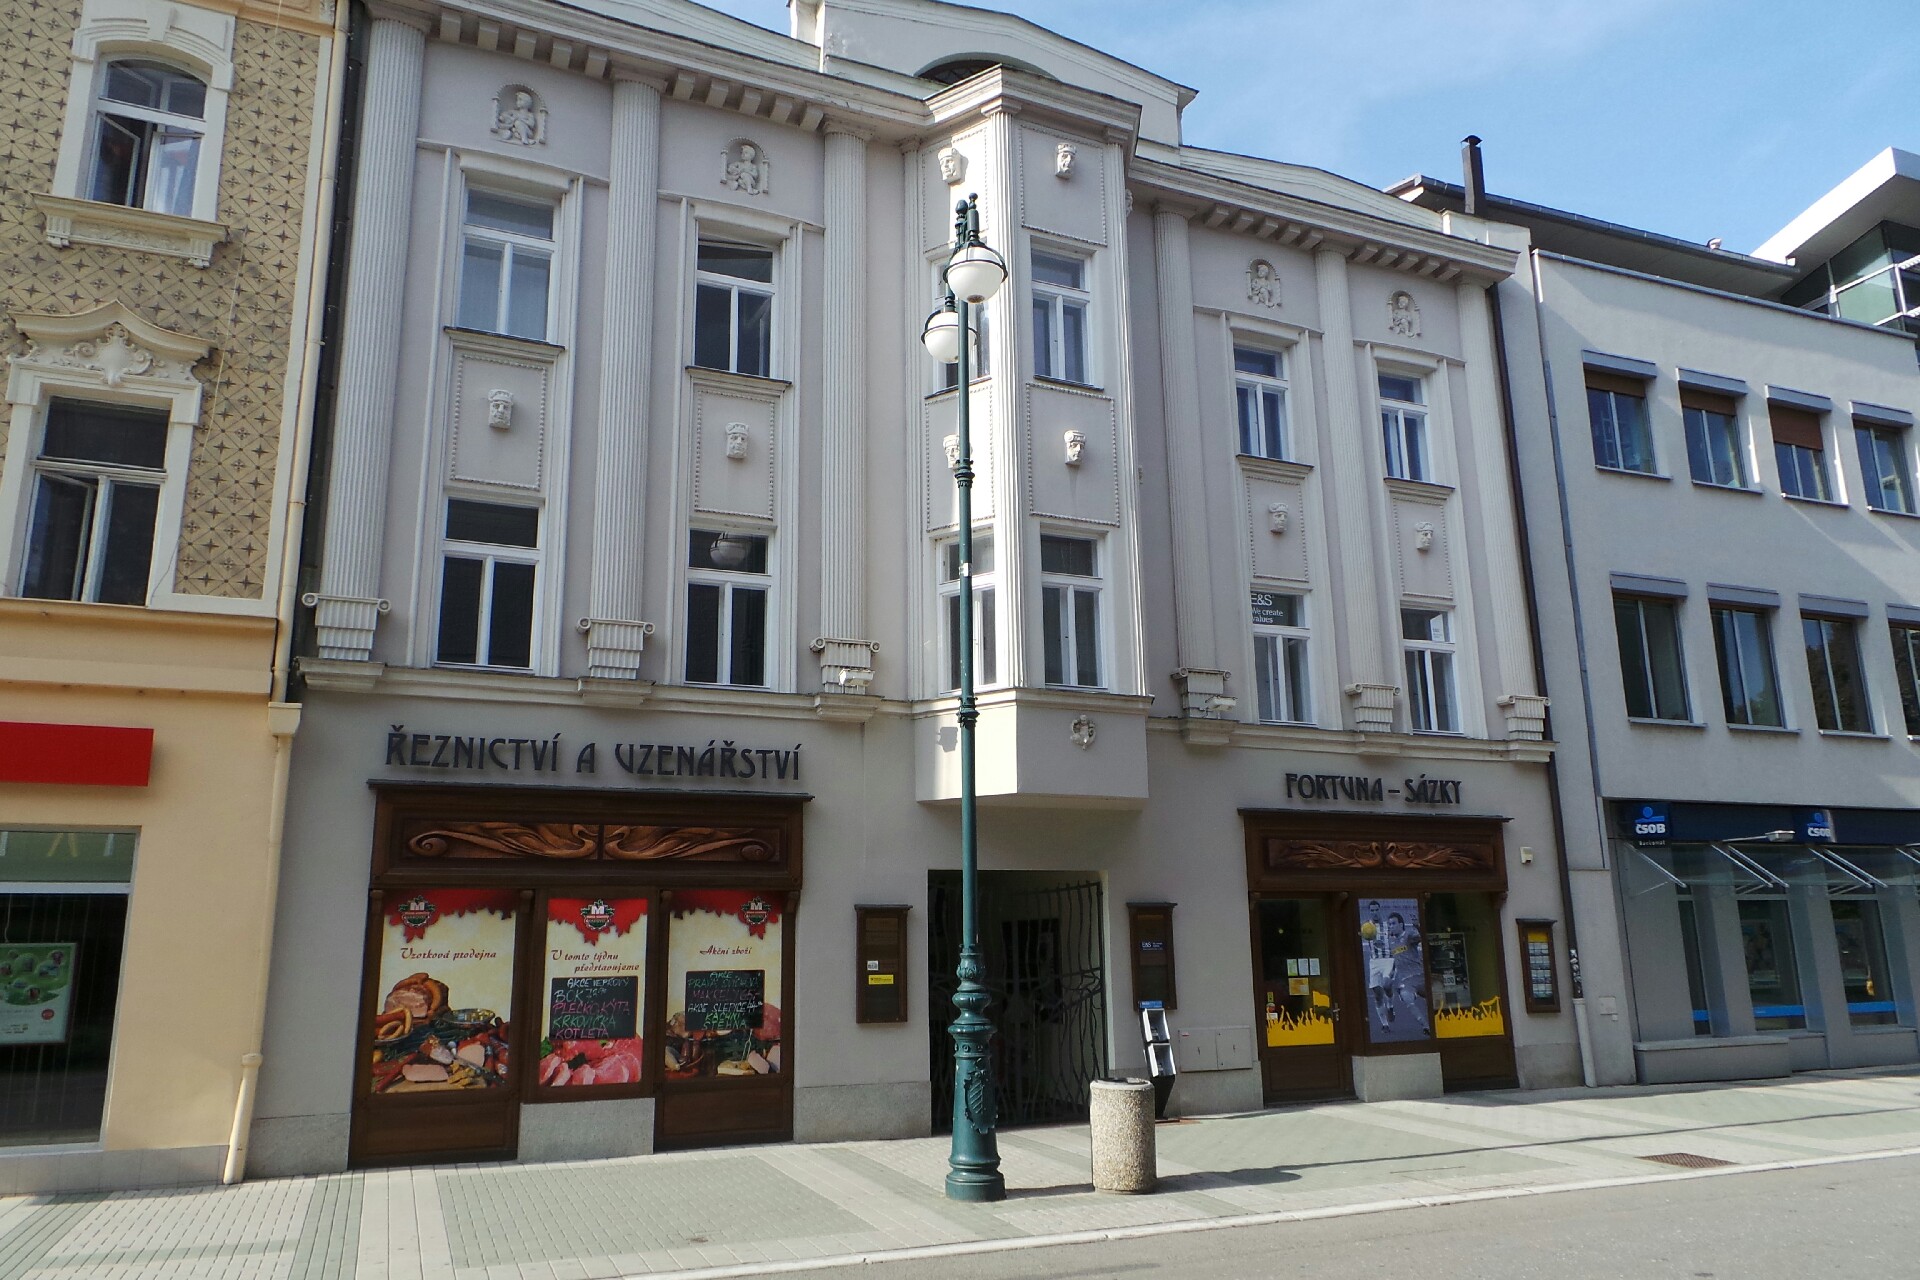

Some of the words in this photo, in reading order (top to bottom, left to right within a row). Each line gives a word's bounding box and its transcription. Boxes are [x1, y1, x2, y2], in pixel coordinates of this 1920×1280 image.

[1262, 609, 1283, 617] create
[384, 724, 562, 771] ŘEZNICTVÍ
[576, 742, 596, 773] A
[615, 740, 802, 781] UZENÁŘSTVÍ
[1285, 773, 1383, 801] FORTUNA
[1404, 774, 1461, 804] SÁZKY
[1636, 823, 1665, 834] ČSOB
[1808, 827, 1831, 837] ČSOB
[591, 906, 604, 914] M
[453, 949, 497, 961] prodejna
[699, 945, 729, 955] Akční
[732, 946, 752, 955] zboží
[594, 952, 619, 962] týdnu
[574, 962, 640, 973] představujeme
[567, 978, 593, 987] AKCE
[555, 1028, 609, 1040] KOTLETA
